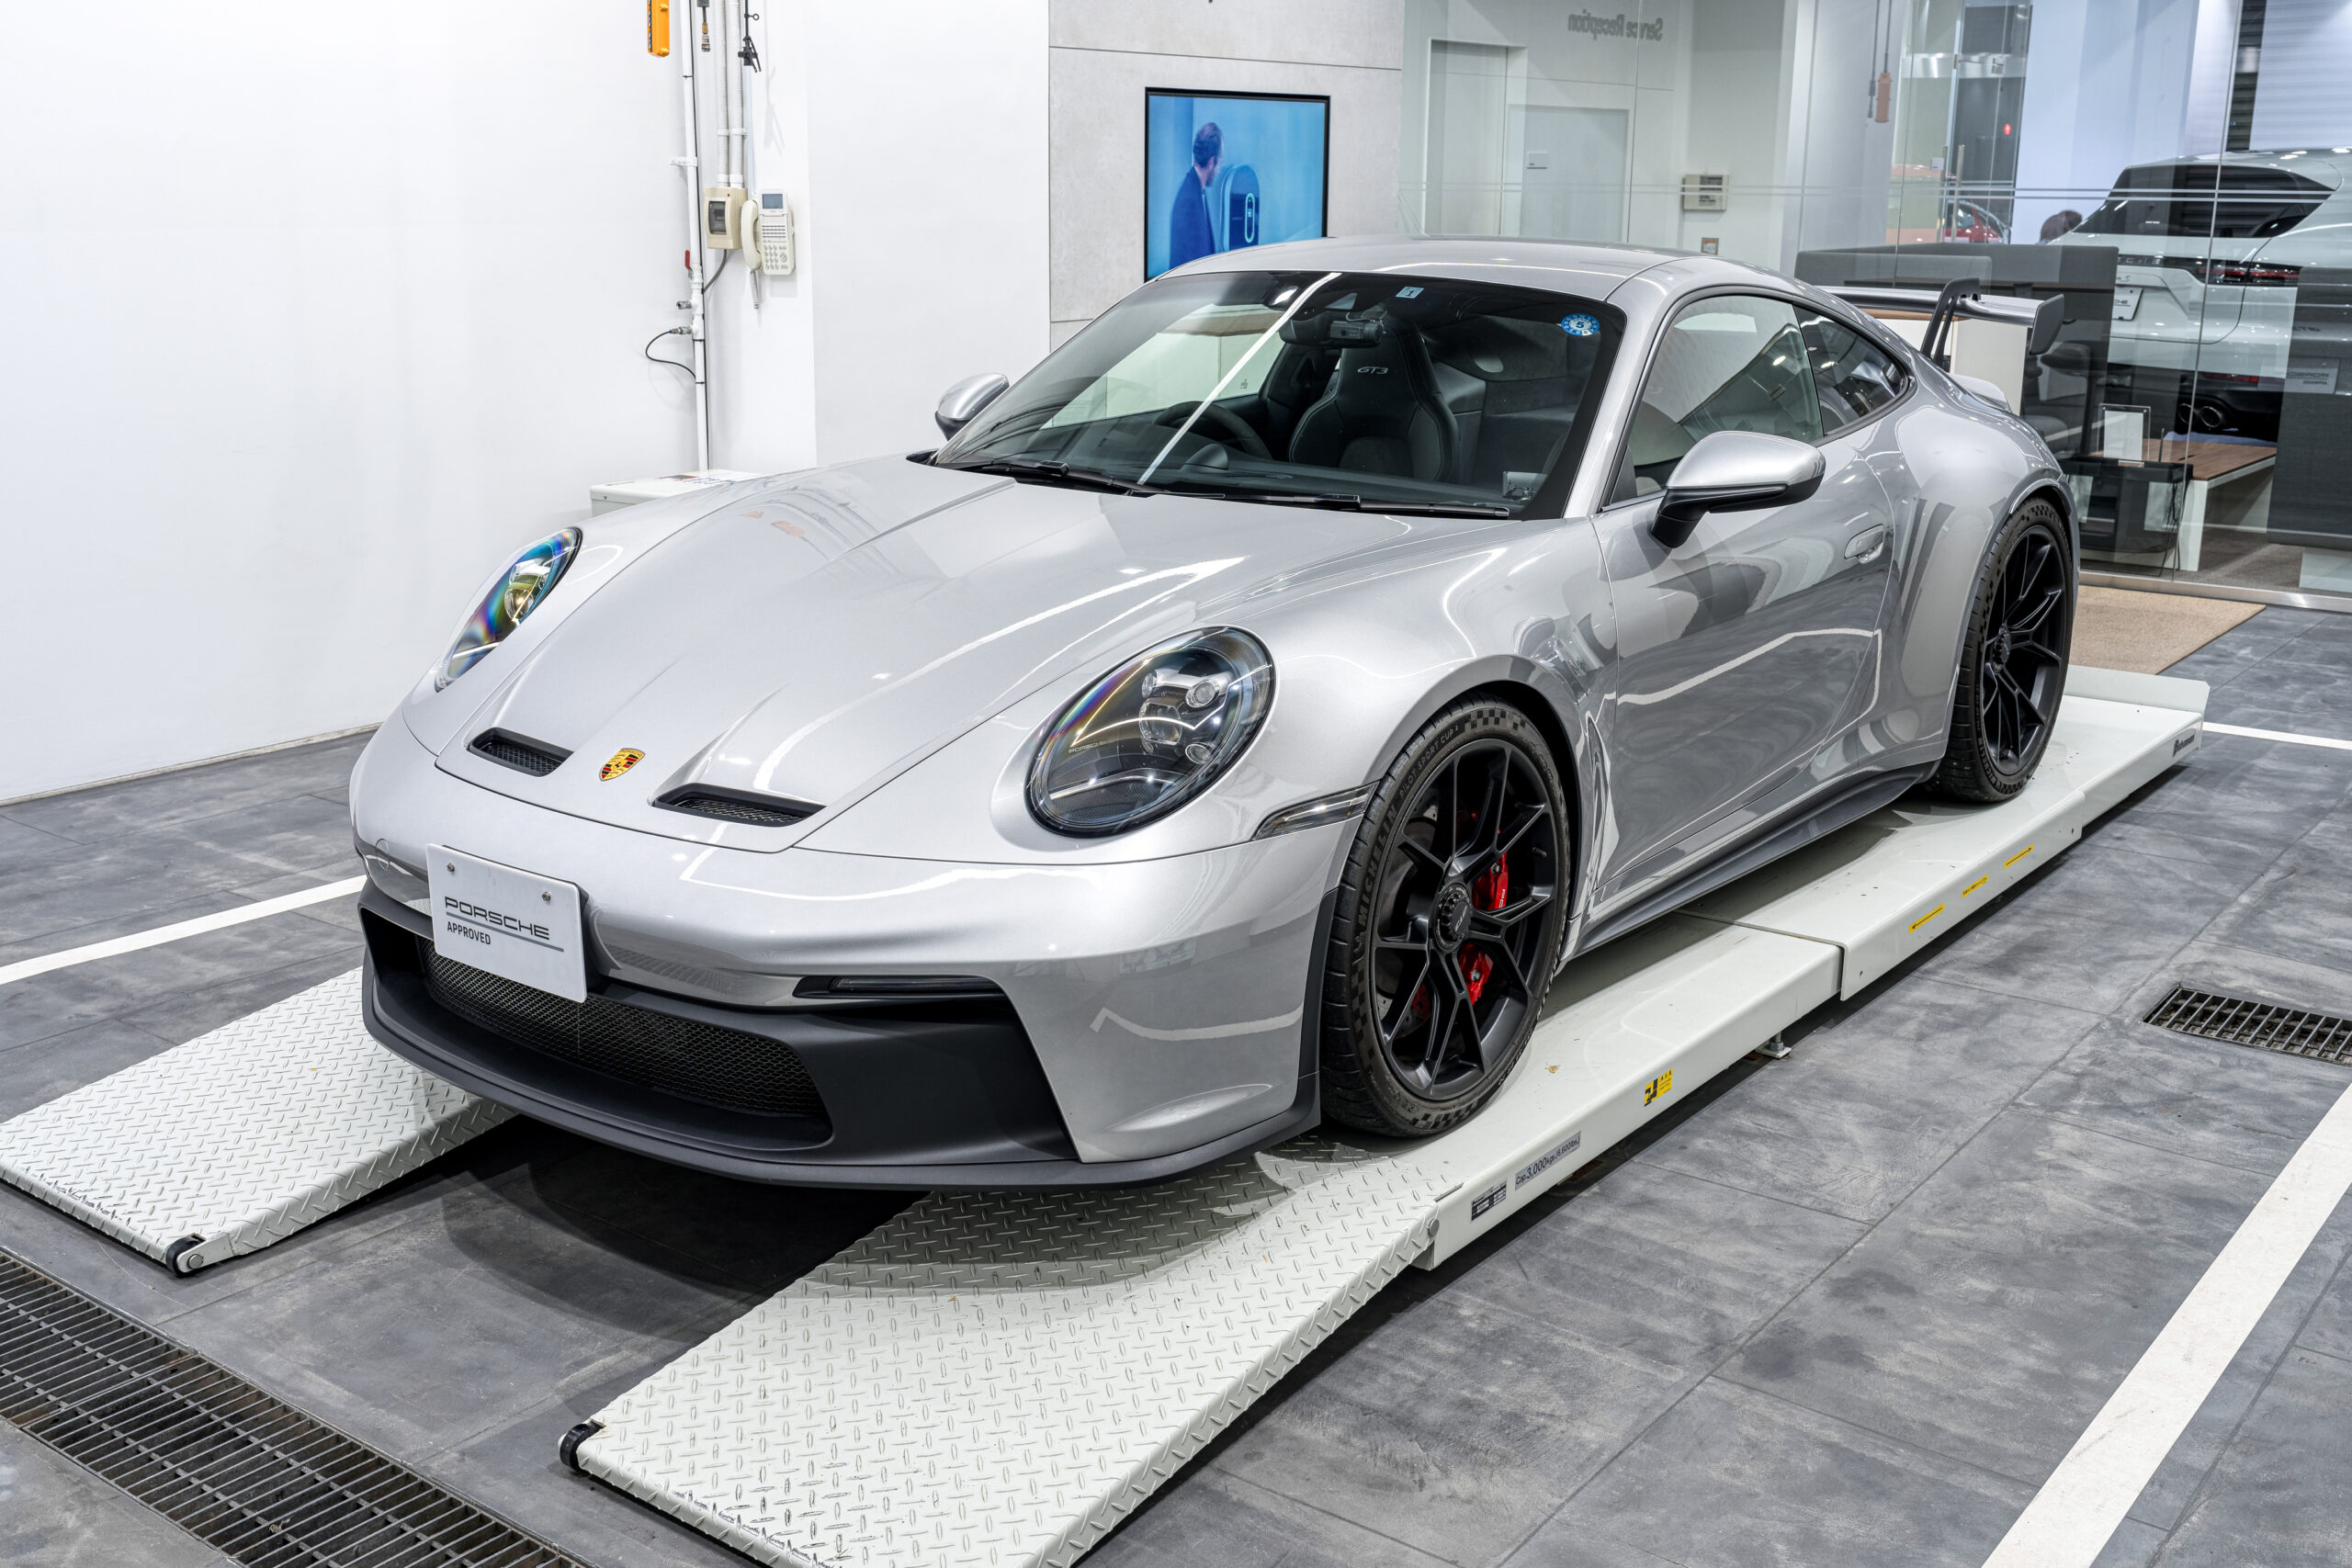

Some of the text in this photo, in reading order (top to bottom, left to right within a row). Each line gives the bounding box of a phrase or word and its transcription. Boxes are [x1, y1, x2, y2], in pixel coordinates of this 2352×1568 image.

[1358, 367, 1388, 375] GT3
[1399, 769, 1417, 799] PILOT
[1418, 740, 1440, 770] SPORT
[1441, 728, 1453, 743] CUP
[1357, 803, 1397, 928] MICHELIN
[445, 897, 549, 940] PORSCHE
[447, 920, 491, 944] APPROVED
